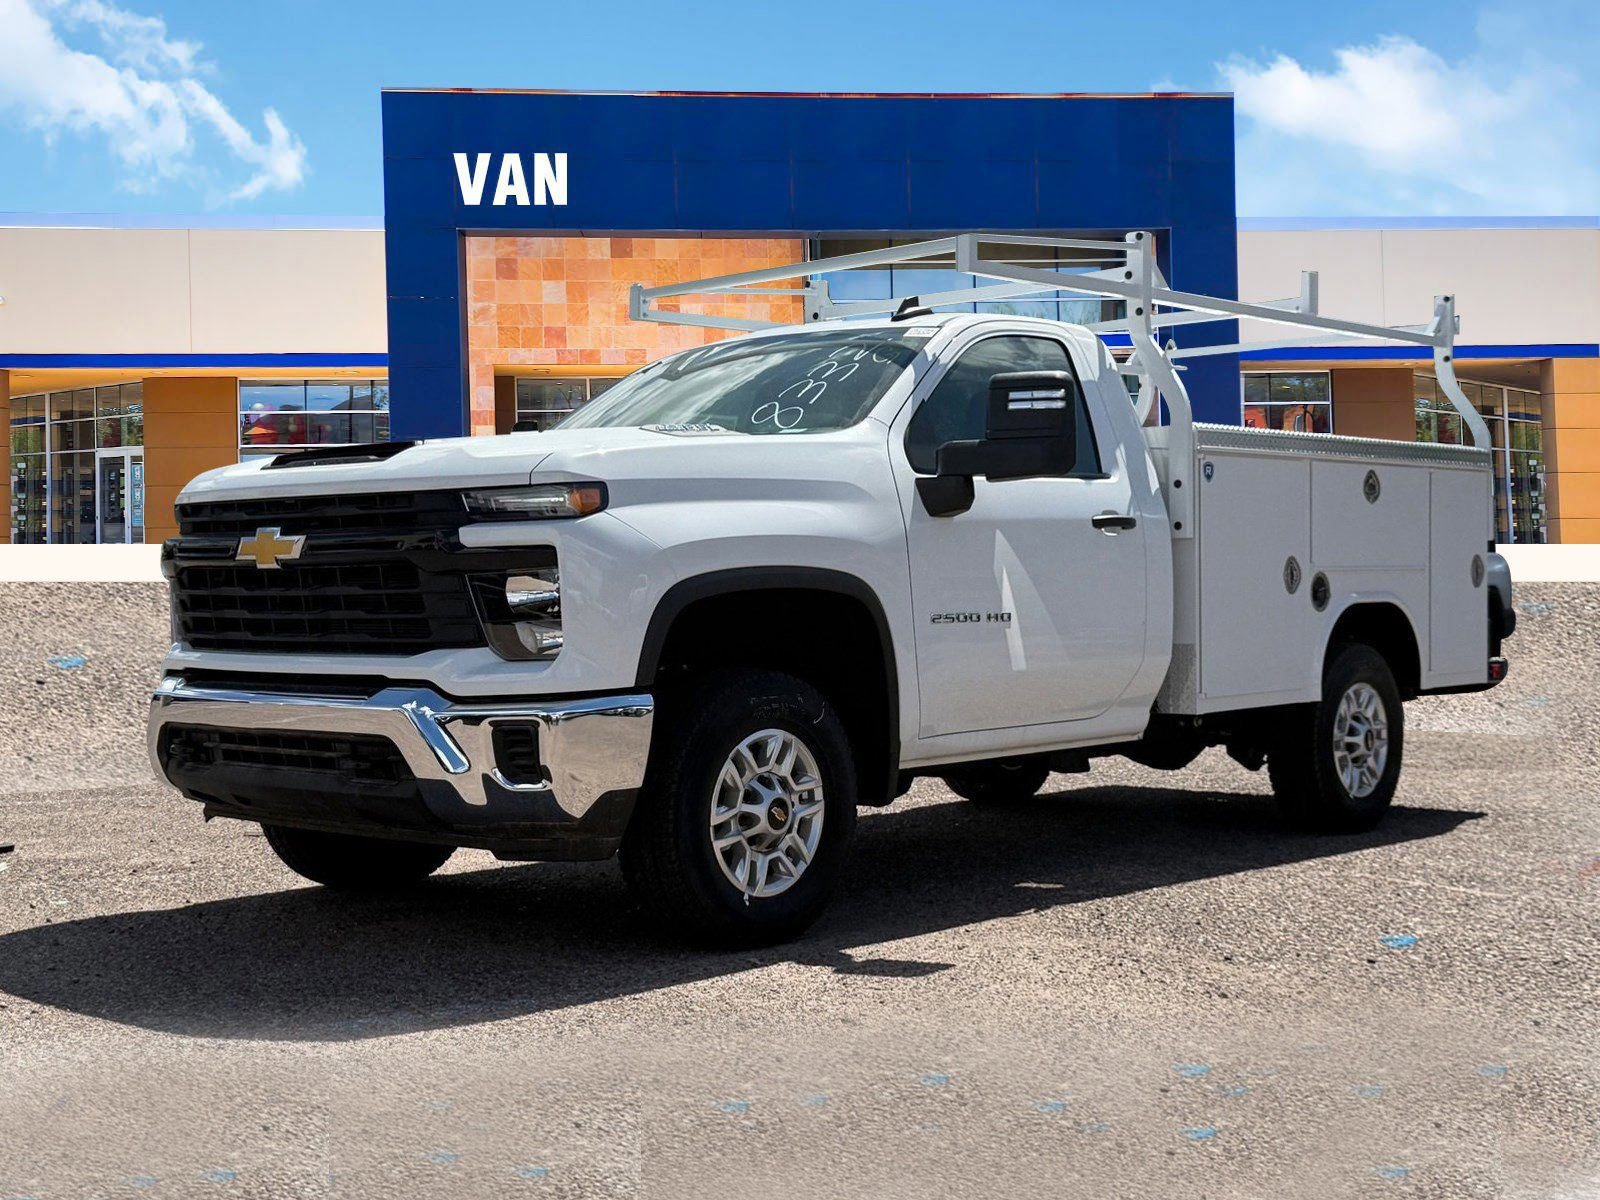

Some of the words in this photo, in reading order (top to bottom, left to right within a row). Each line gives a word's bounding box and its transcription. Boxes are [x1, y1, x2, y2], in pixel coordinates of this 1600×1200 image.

[453, 152, 568, 206] VAN
[930, 612, 981, 624] 2500
[986, 612, 1012, 623] HD
